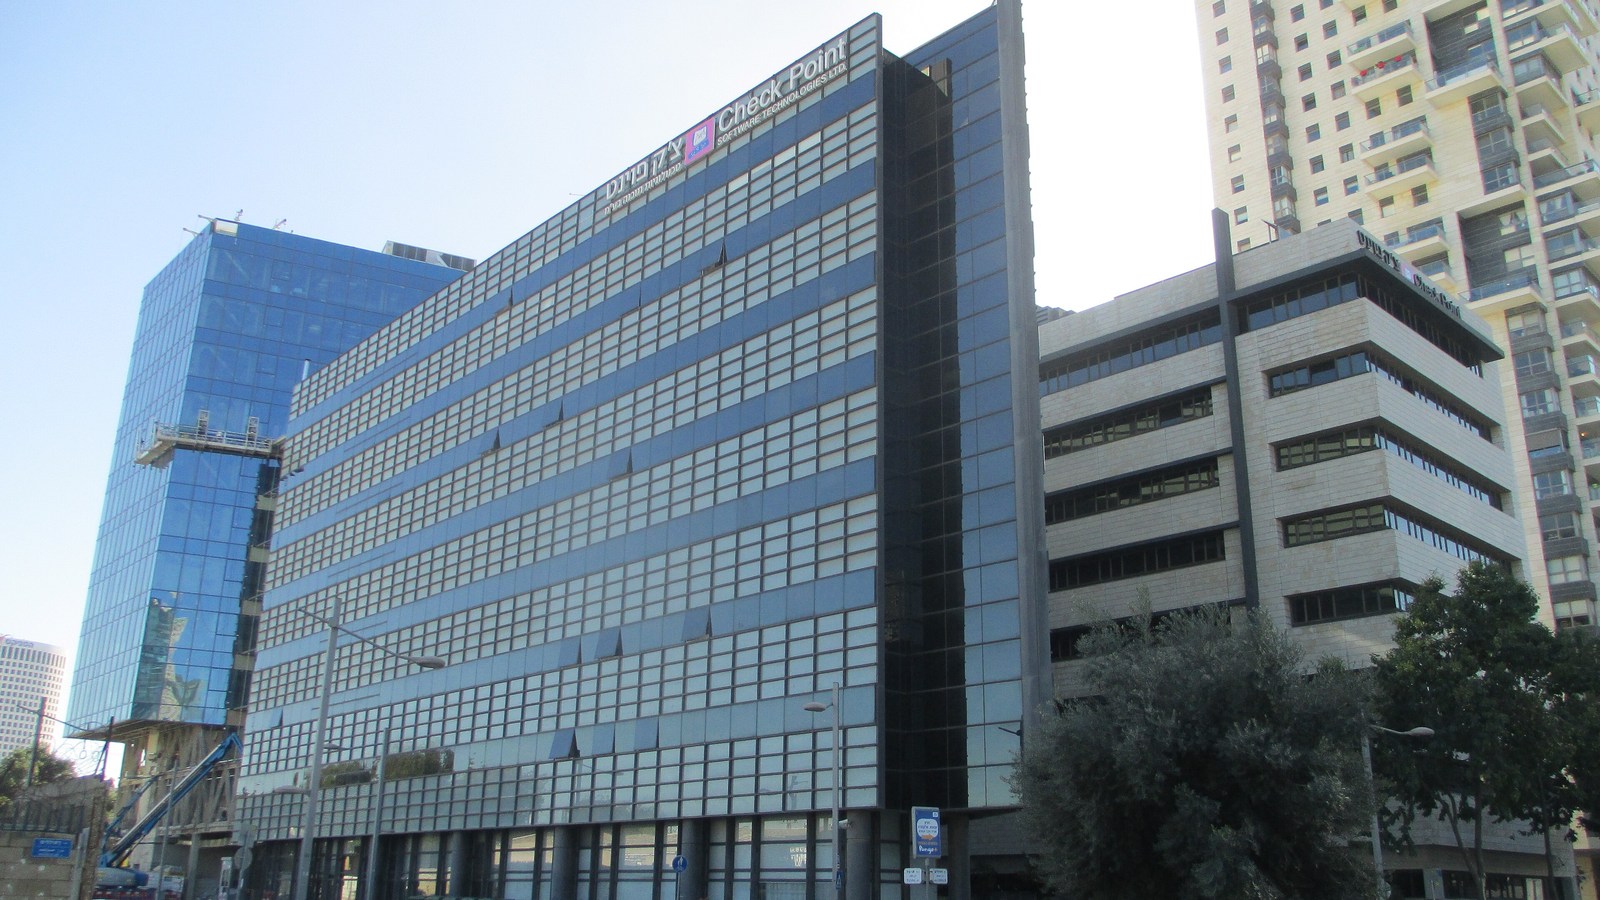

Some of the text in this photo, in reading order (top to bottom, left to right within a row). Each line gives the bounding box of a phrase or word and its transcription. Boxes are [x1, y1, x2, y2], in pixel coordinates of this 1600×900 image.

[717, 117, 760, 146] SOFTWARE
[763, 75, 827, 117] TECHNOLOGIES
[718, 38, 848, 132] Check Point
[606, 160, 649, 200] פוינט
